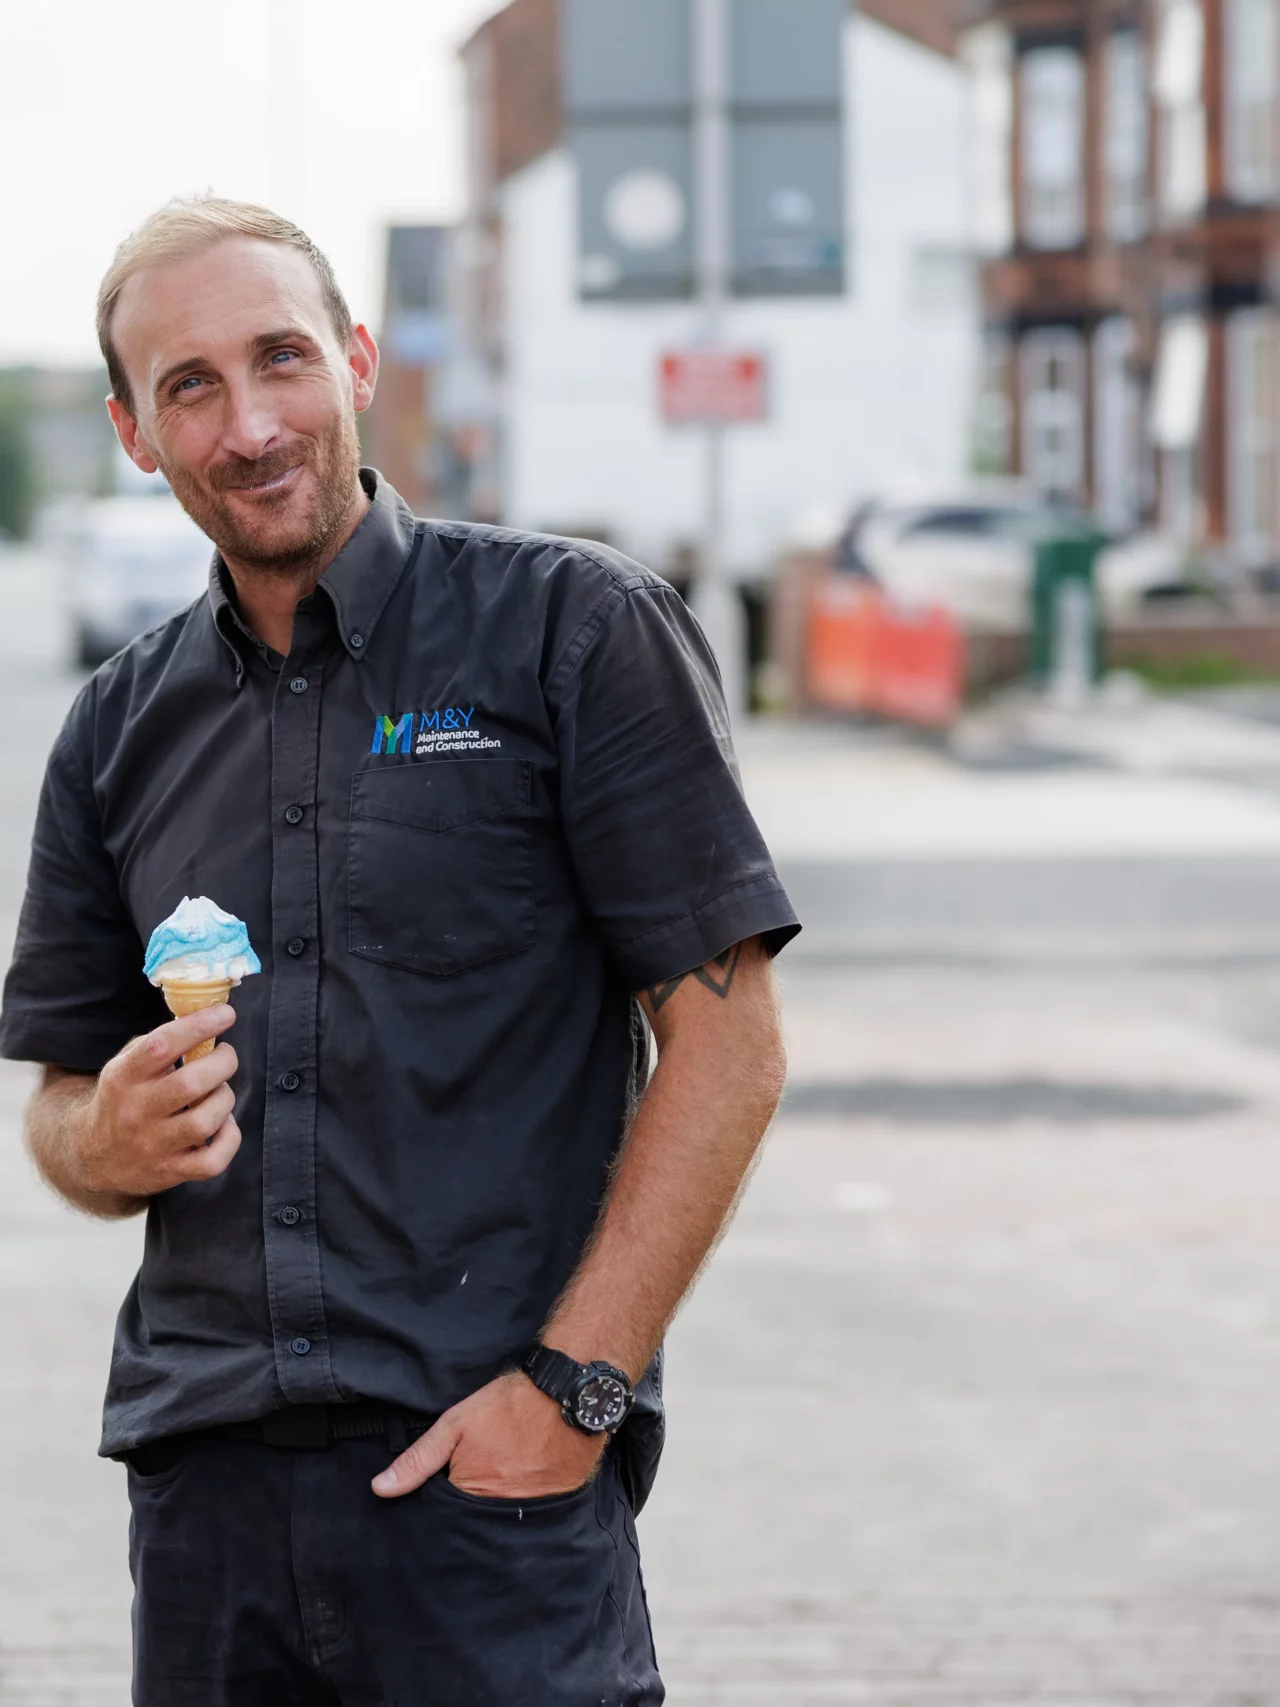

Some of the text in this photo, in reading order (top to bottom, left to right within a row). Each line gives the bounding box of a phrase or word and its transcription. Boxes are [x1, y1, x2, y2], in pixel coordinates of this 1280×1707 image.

[419, 707, 475, 732] M&Y
[416, 730, 480, 743] Maintenance
[416, 737, 501, 754] and Construction
